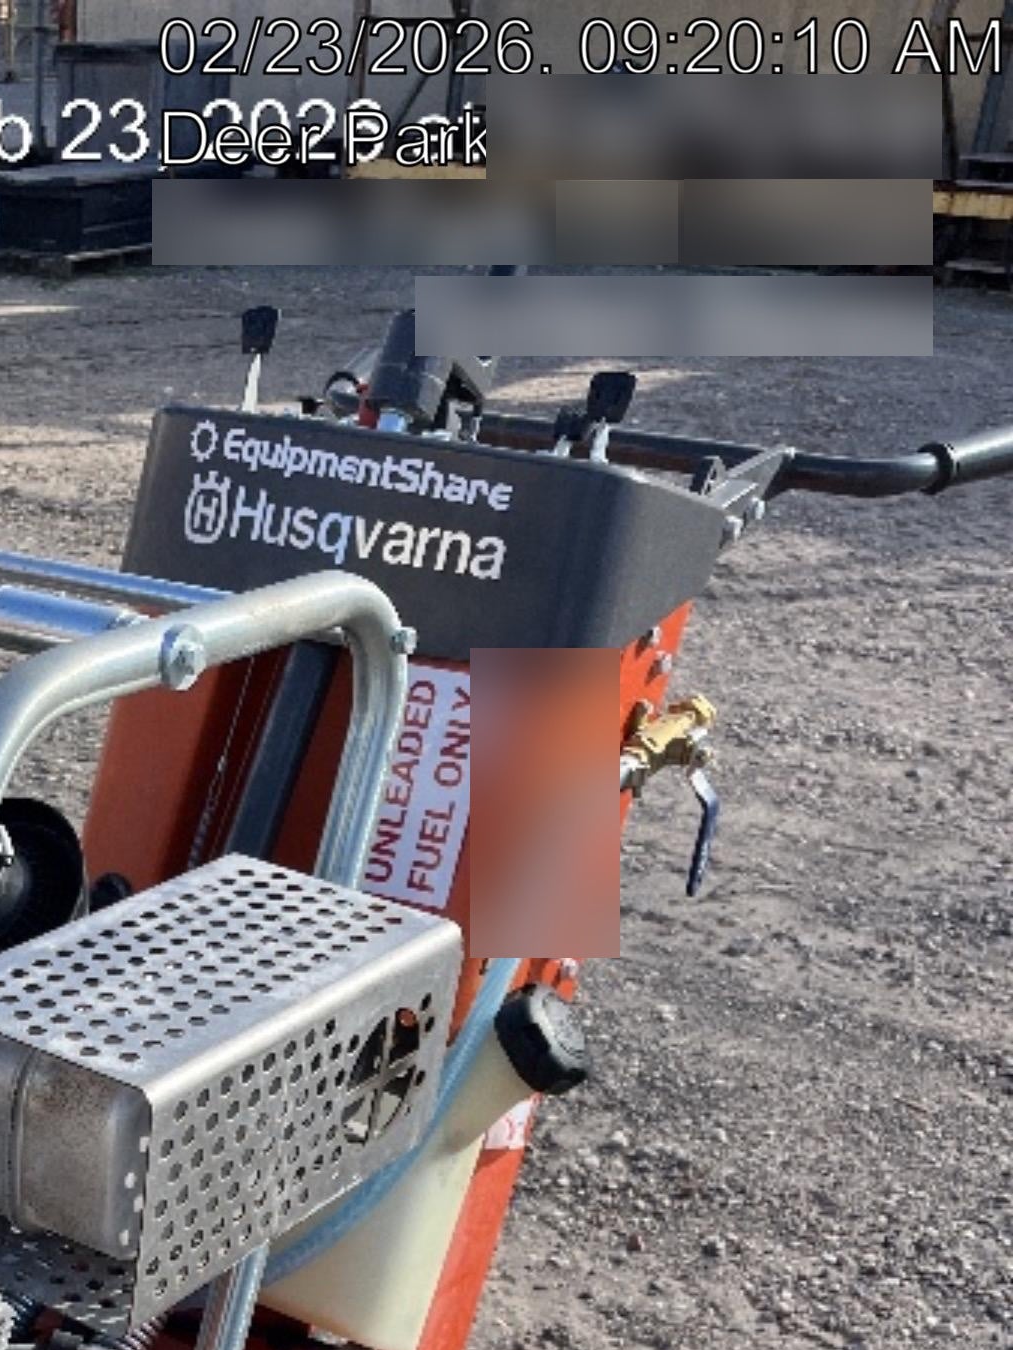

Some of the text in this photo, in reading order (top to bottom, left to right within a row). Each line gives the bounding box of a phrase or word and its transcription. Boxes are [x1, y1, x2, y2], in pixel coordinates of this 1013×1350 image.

[223, 428, 513, 511] EquipmentShare
[229, 485, 507, 580] Husqvarna
[365, 680, 437, 882] UNLEADED
[406, 800, 456, 892] FUEL
